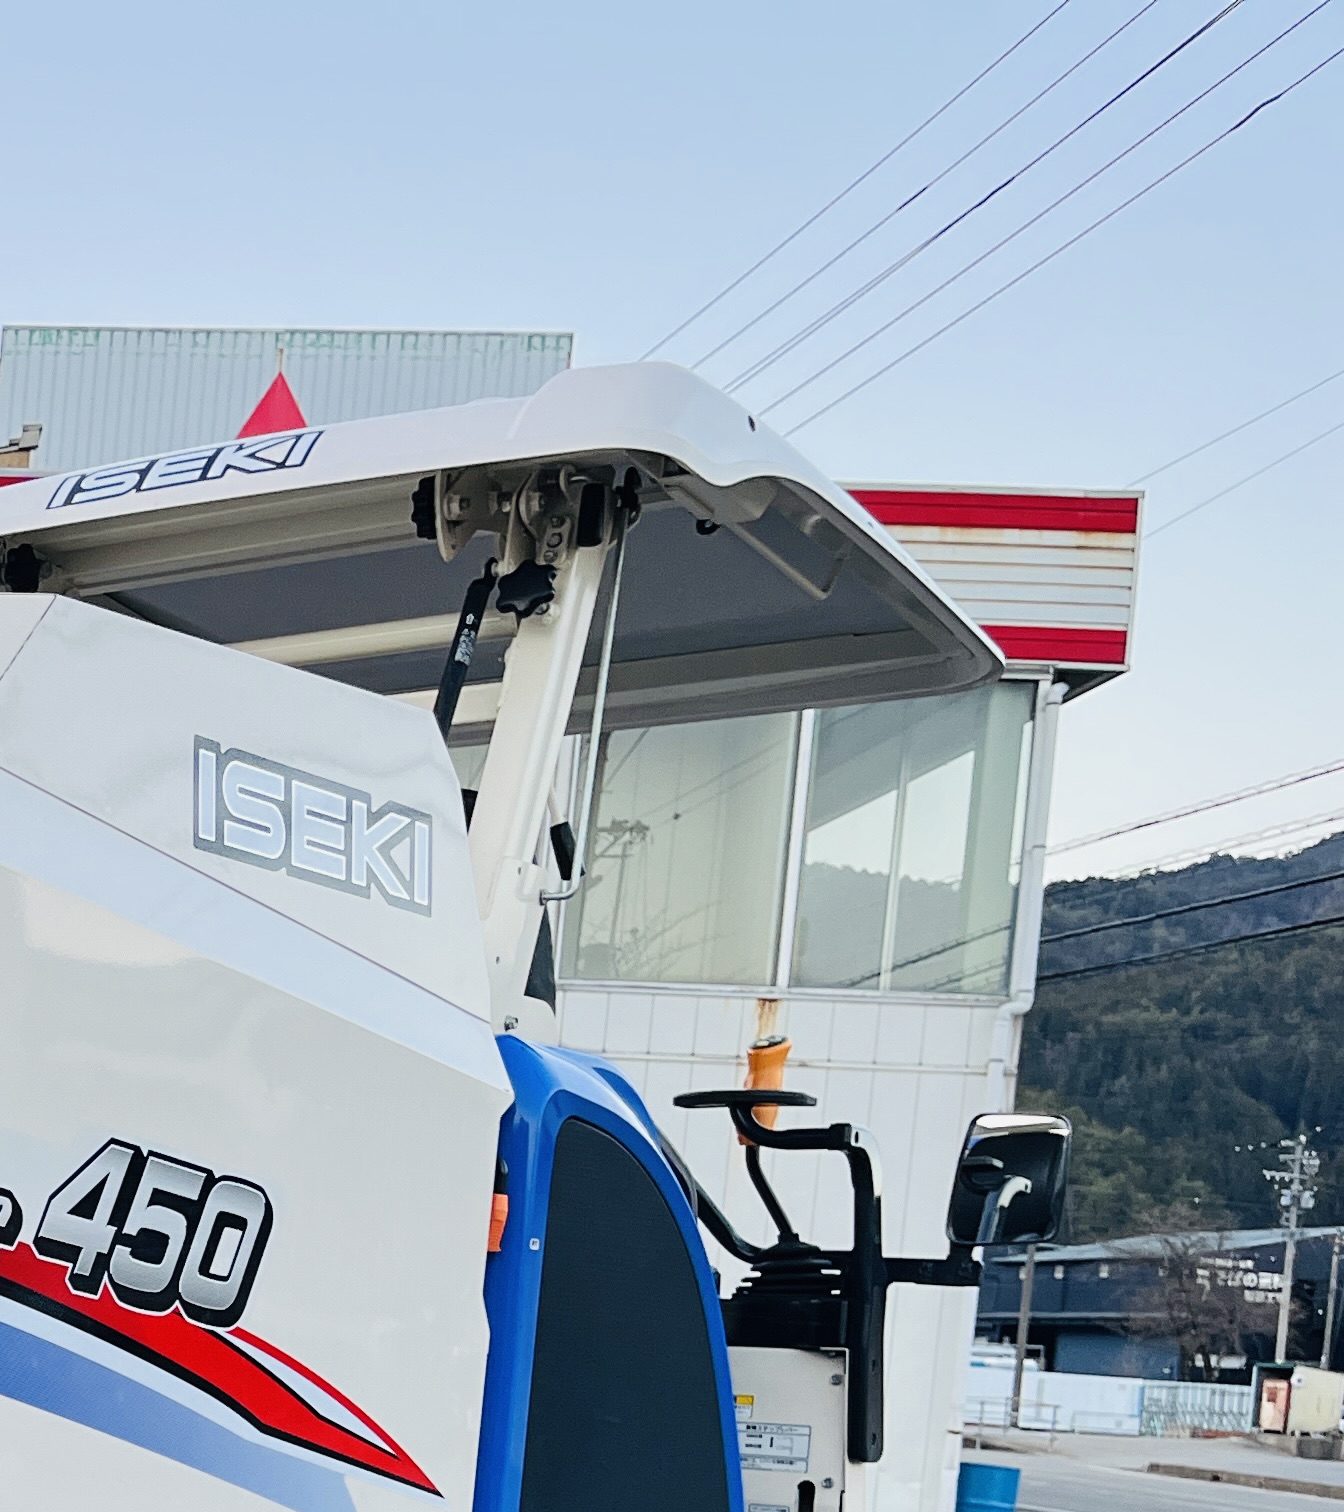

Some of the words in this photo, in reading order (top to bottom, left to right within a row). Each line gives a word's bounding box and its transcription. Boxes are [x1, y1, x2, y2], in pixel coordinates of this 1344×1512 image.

[46, 430, 326, 510] ISEKI
[193, 734, 433, 918] ISEKI
[33, 1137, 274, 1328] 450
